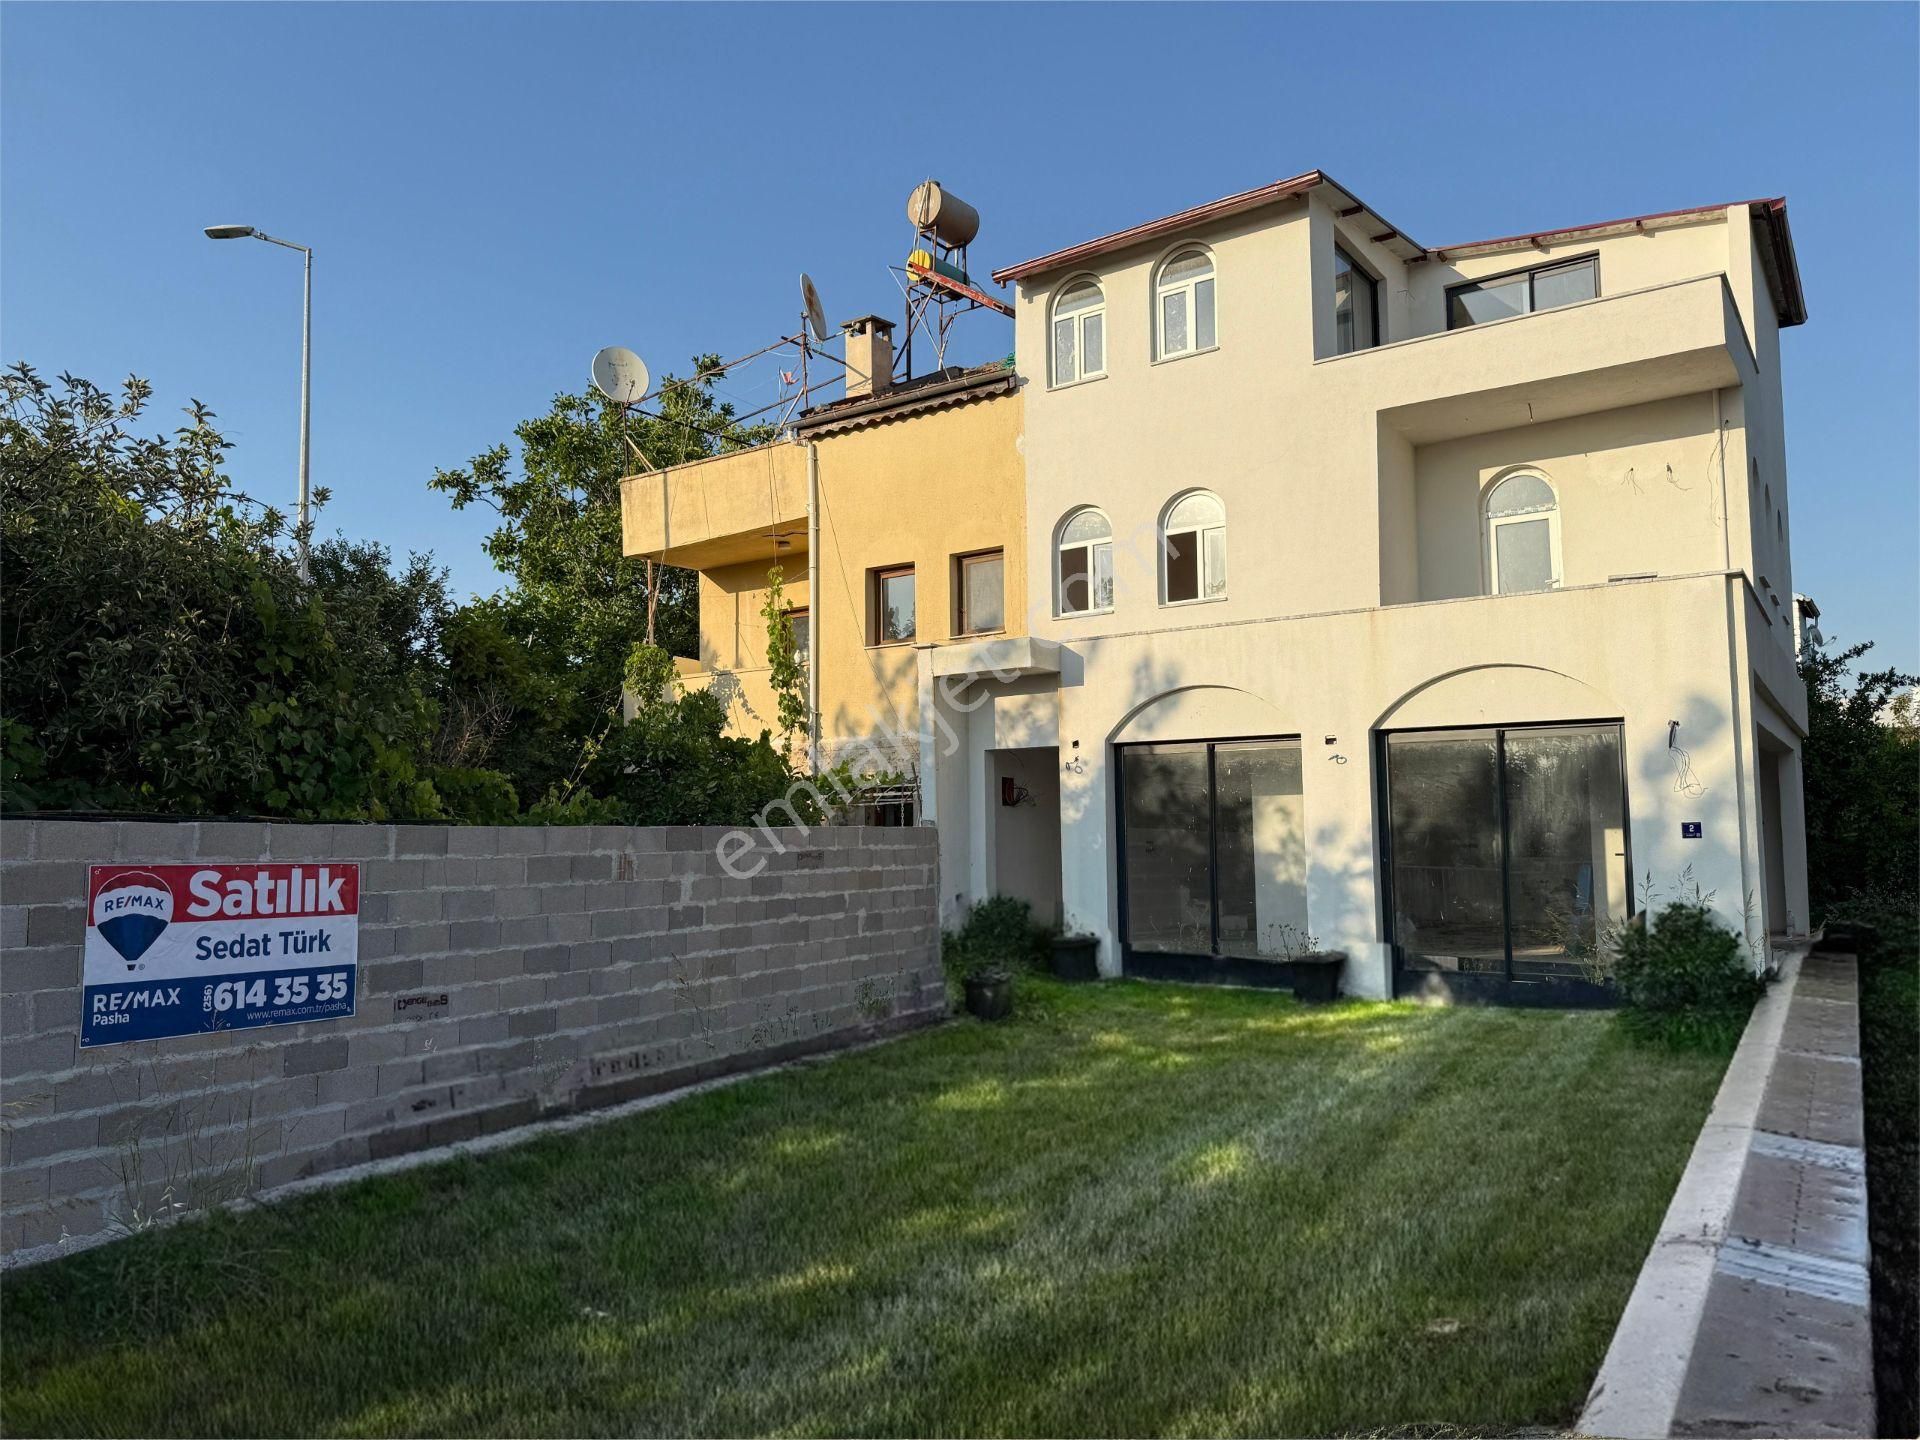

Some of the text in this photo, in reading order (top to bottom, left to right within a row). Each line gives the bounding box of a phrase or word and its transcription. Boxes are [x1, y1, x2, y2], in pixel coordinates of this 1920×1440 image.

[1688, 824, 1695, 833] 2
[104, 895, 165, 912] RE/MAX
[187, 867, 347, 918] Satılık
[195, 929, 332, 960] Sedat Türk
[93, 987, 181, 1013] RE/MAX
[203, 972, 348, 1012] (256) 614 35 35
[92, 1012, 130, 1026] Pasha
[246, 1001, 347, 1020] www.remax.com.tr/pasha
